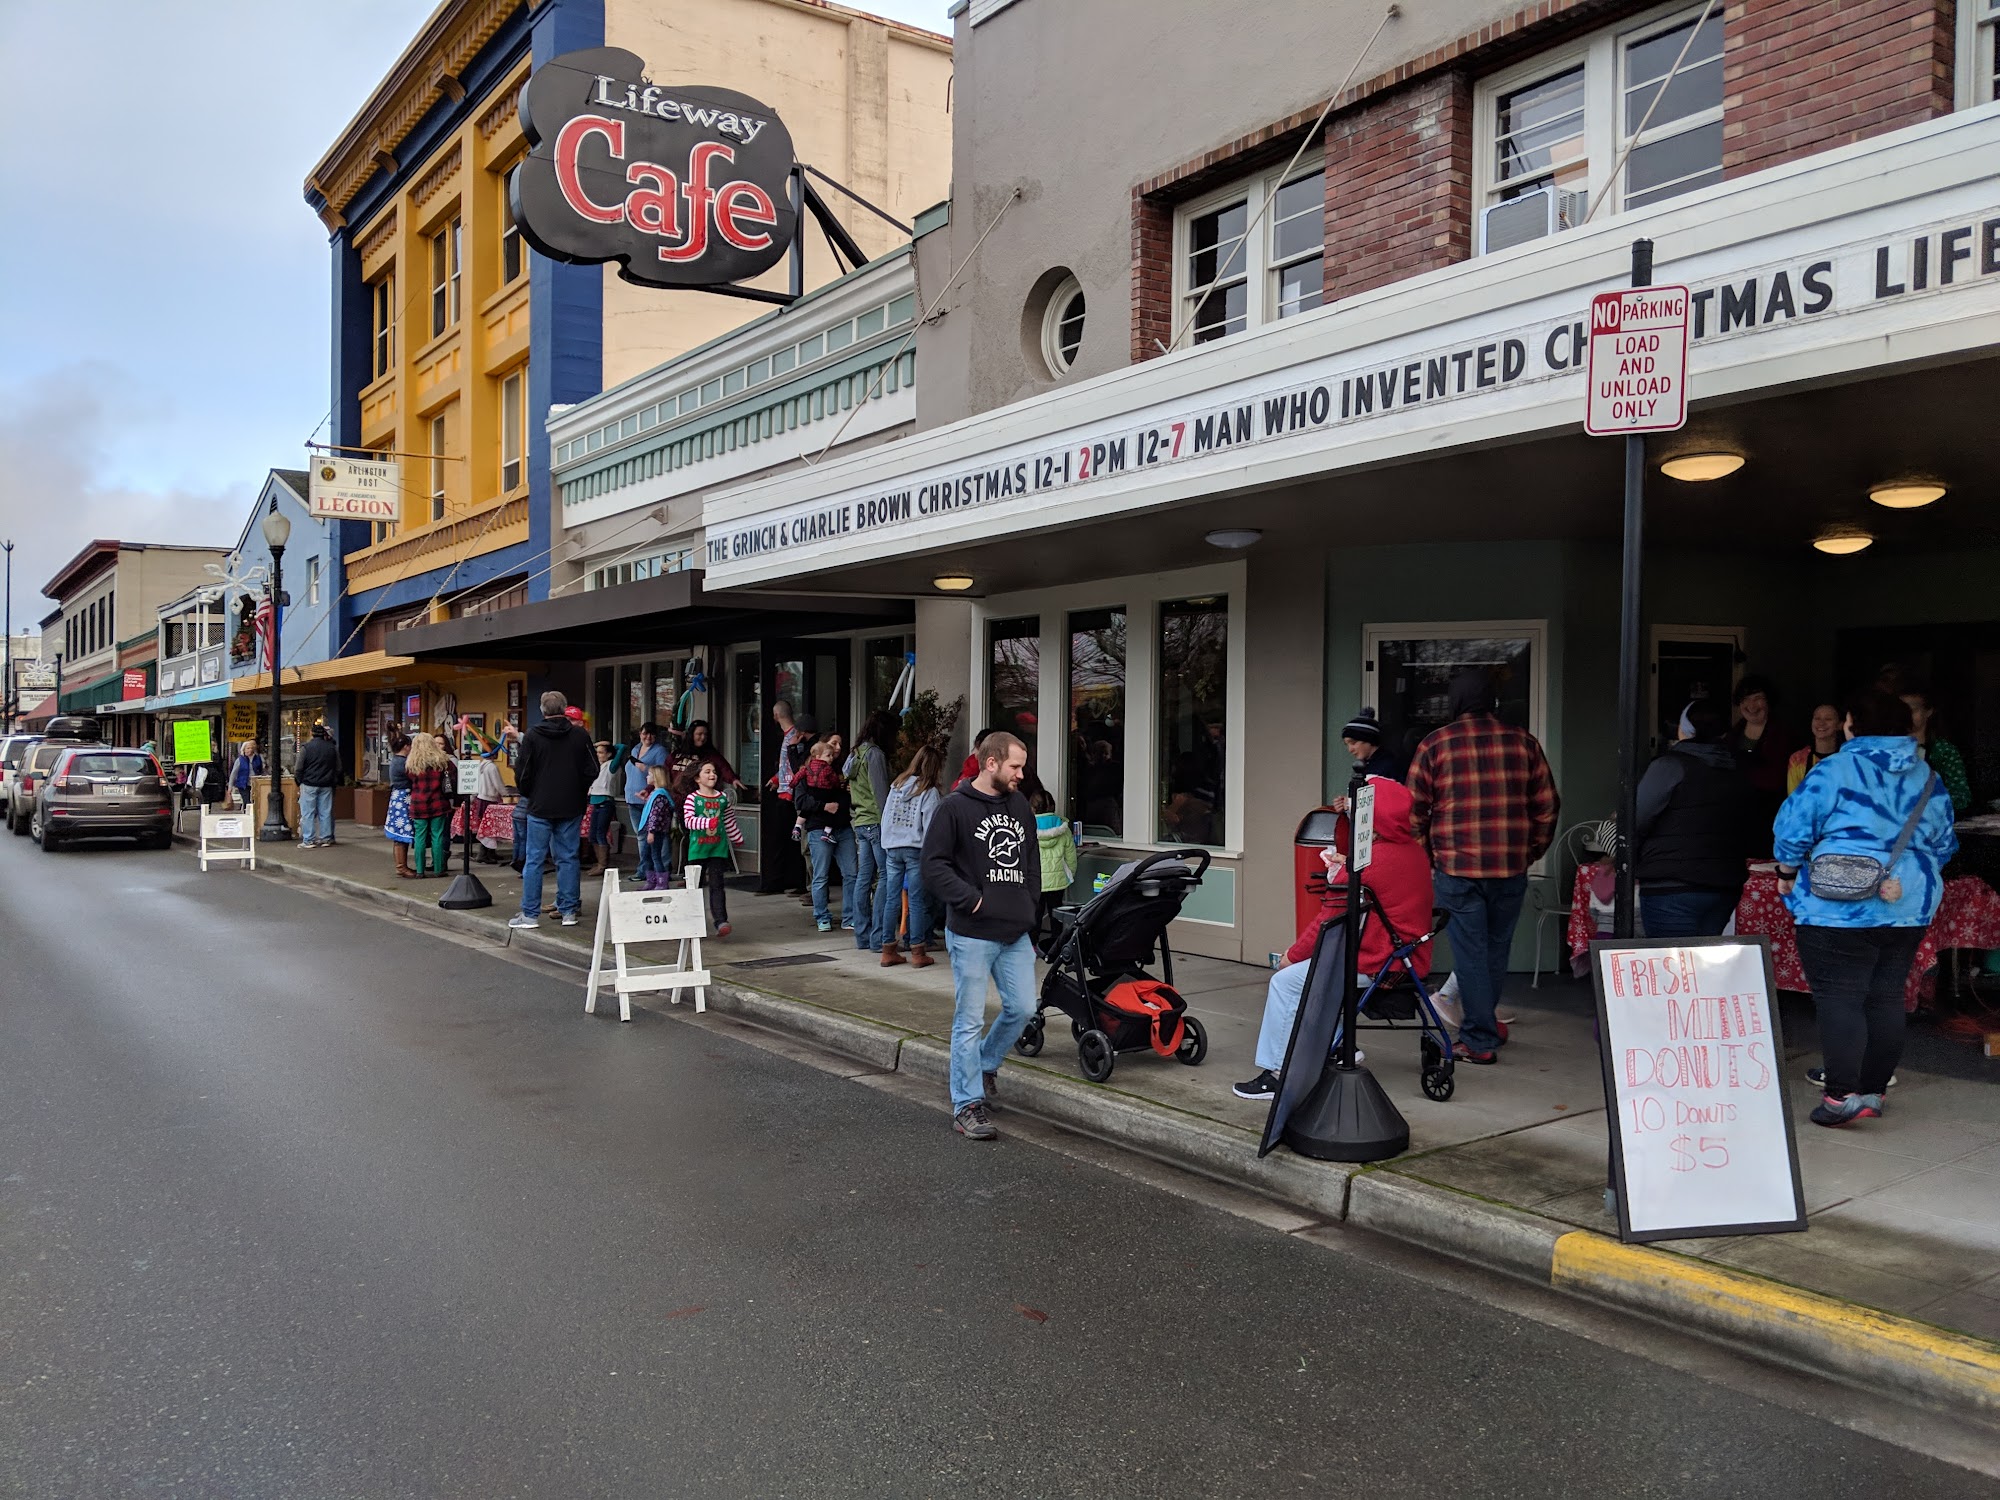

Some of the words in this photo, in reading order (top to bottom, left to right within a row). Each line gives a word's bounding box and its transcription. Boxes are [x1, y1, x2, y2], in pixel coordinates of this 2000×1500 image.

[594, 75, 766, 144] Lifeway
[554, 114, 777, 262] Cafe
[1593, 300, 1619, 329] NO
[1623, 298, 1683, 321] PARKING
[1615, 335, 1660, 355] LOAD
[1618, 356, 1655, 376] AND
[707, 536, 728, 563] THE
[733, 524, 776, 557] GRINCH
[780, 526, 788, 546] &
[791, 506, 850, 543] CHARLIE
[856, 491, 911, 529] BROWN
[917, 462, 1026, 515] CHRISTMAS
[1137, 422, 1186, 466] 12-7
[1194, 404, 1253, 453] MAN
[1263, 386, 1331, 436] WHO
[1341, 338, 1527, 419] INVENTED
[1545, 260, 1833, 371] CHTMAS
[1875, 218, 2000, 300] LIFE
[1601, 376, 1671, 399] UNLOAD
[1612, 398, 1657, 419] ONLY
[348, 466, 387, 477] ARLINGTON
[358, 478, 378, 487] POST
[318, 497, 395, 516] LEGION
[229, 731, 255, 739] Design
[1356, 794, 1374, 809] DROP-OFF
[1357, 829, 1370, 843] PICK-UP
[1359, 847, 1367, 860] ONLY
[645, 914, 668, 924] COA
[1610, 950, 1699, 997] FRESH
[1667, 992, 1767, 1041] MINI
[1625, 1041, 1770, 1091] DONUTS
[1629, 1096, 1666, 1134] 10
[1676, 1100, 1738, 1127] DONUTS
[1669, 1133, 1730, 1172] $5
